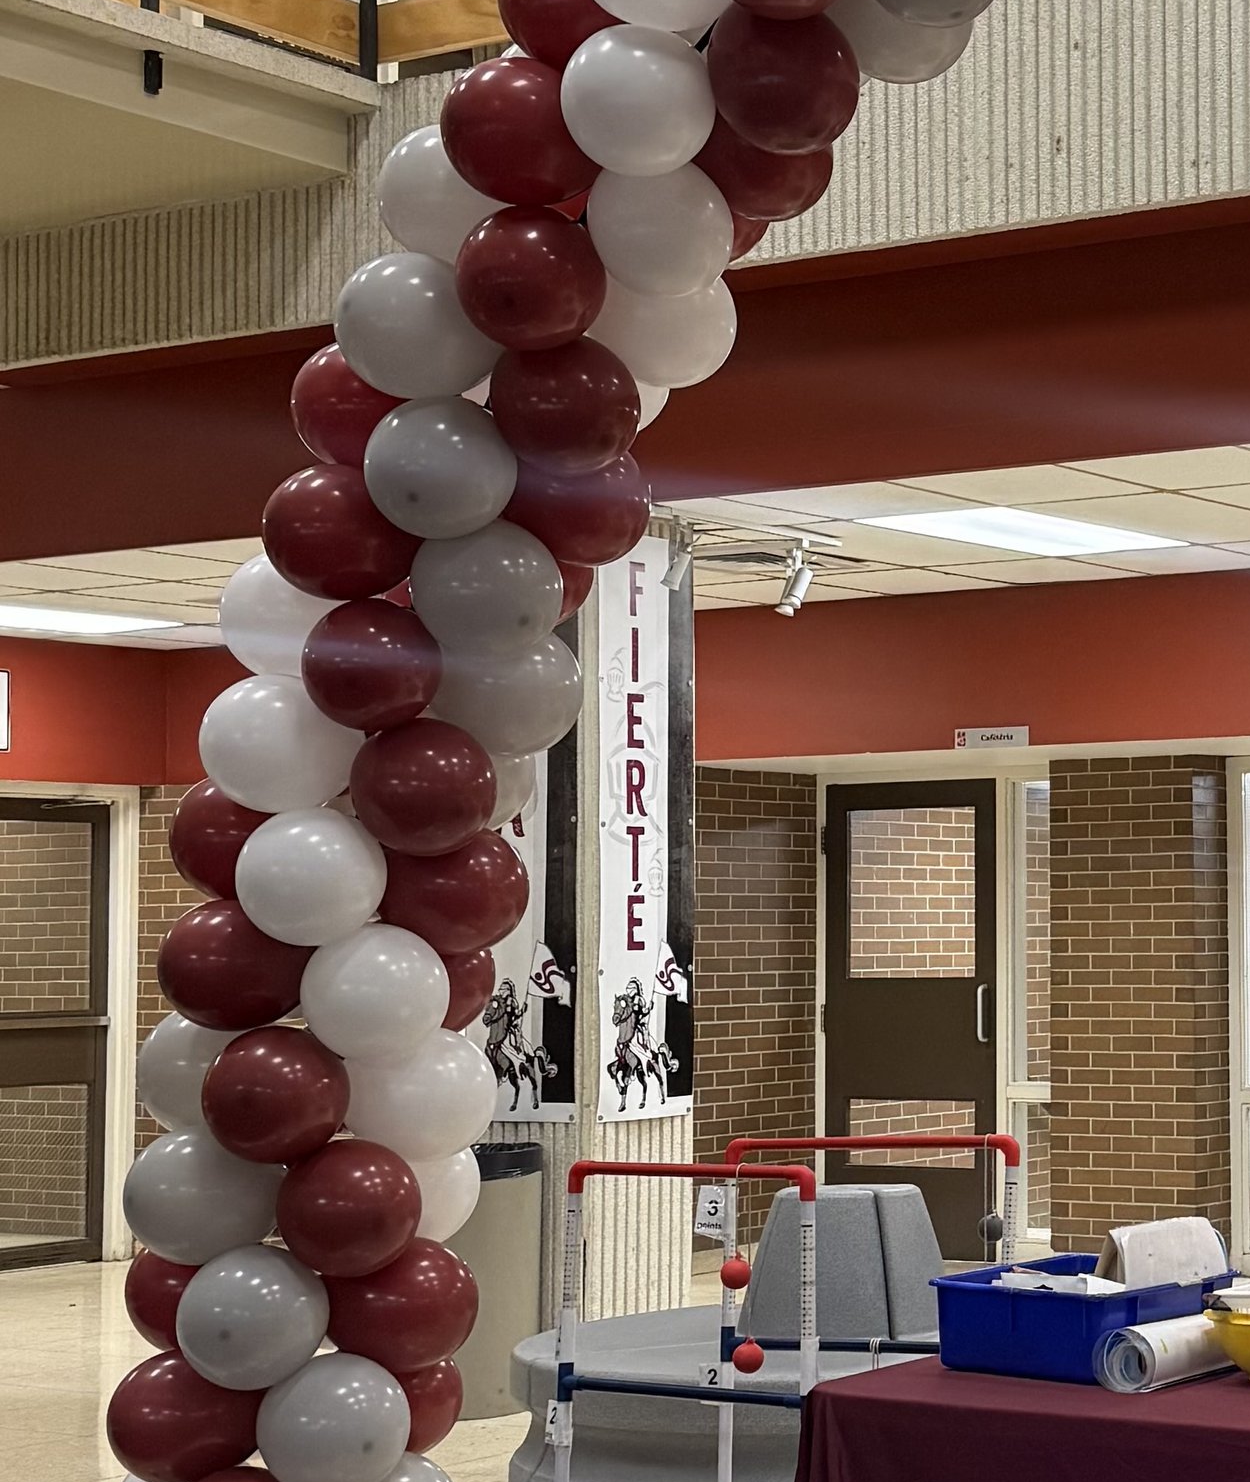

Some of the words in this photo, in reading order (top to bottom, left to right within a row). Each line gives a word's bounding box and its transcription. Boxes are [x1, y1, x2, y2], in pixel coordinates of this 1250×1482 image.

[626, 560, 646, 952] FIERTÉ
[707, 1369, 718, 1385] 2
[549, 1406, 558, 1424] 2
